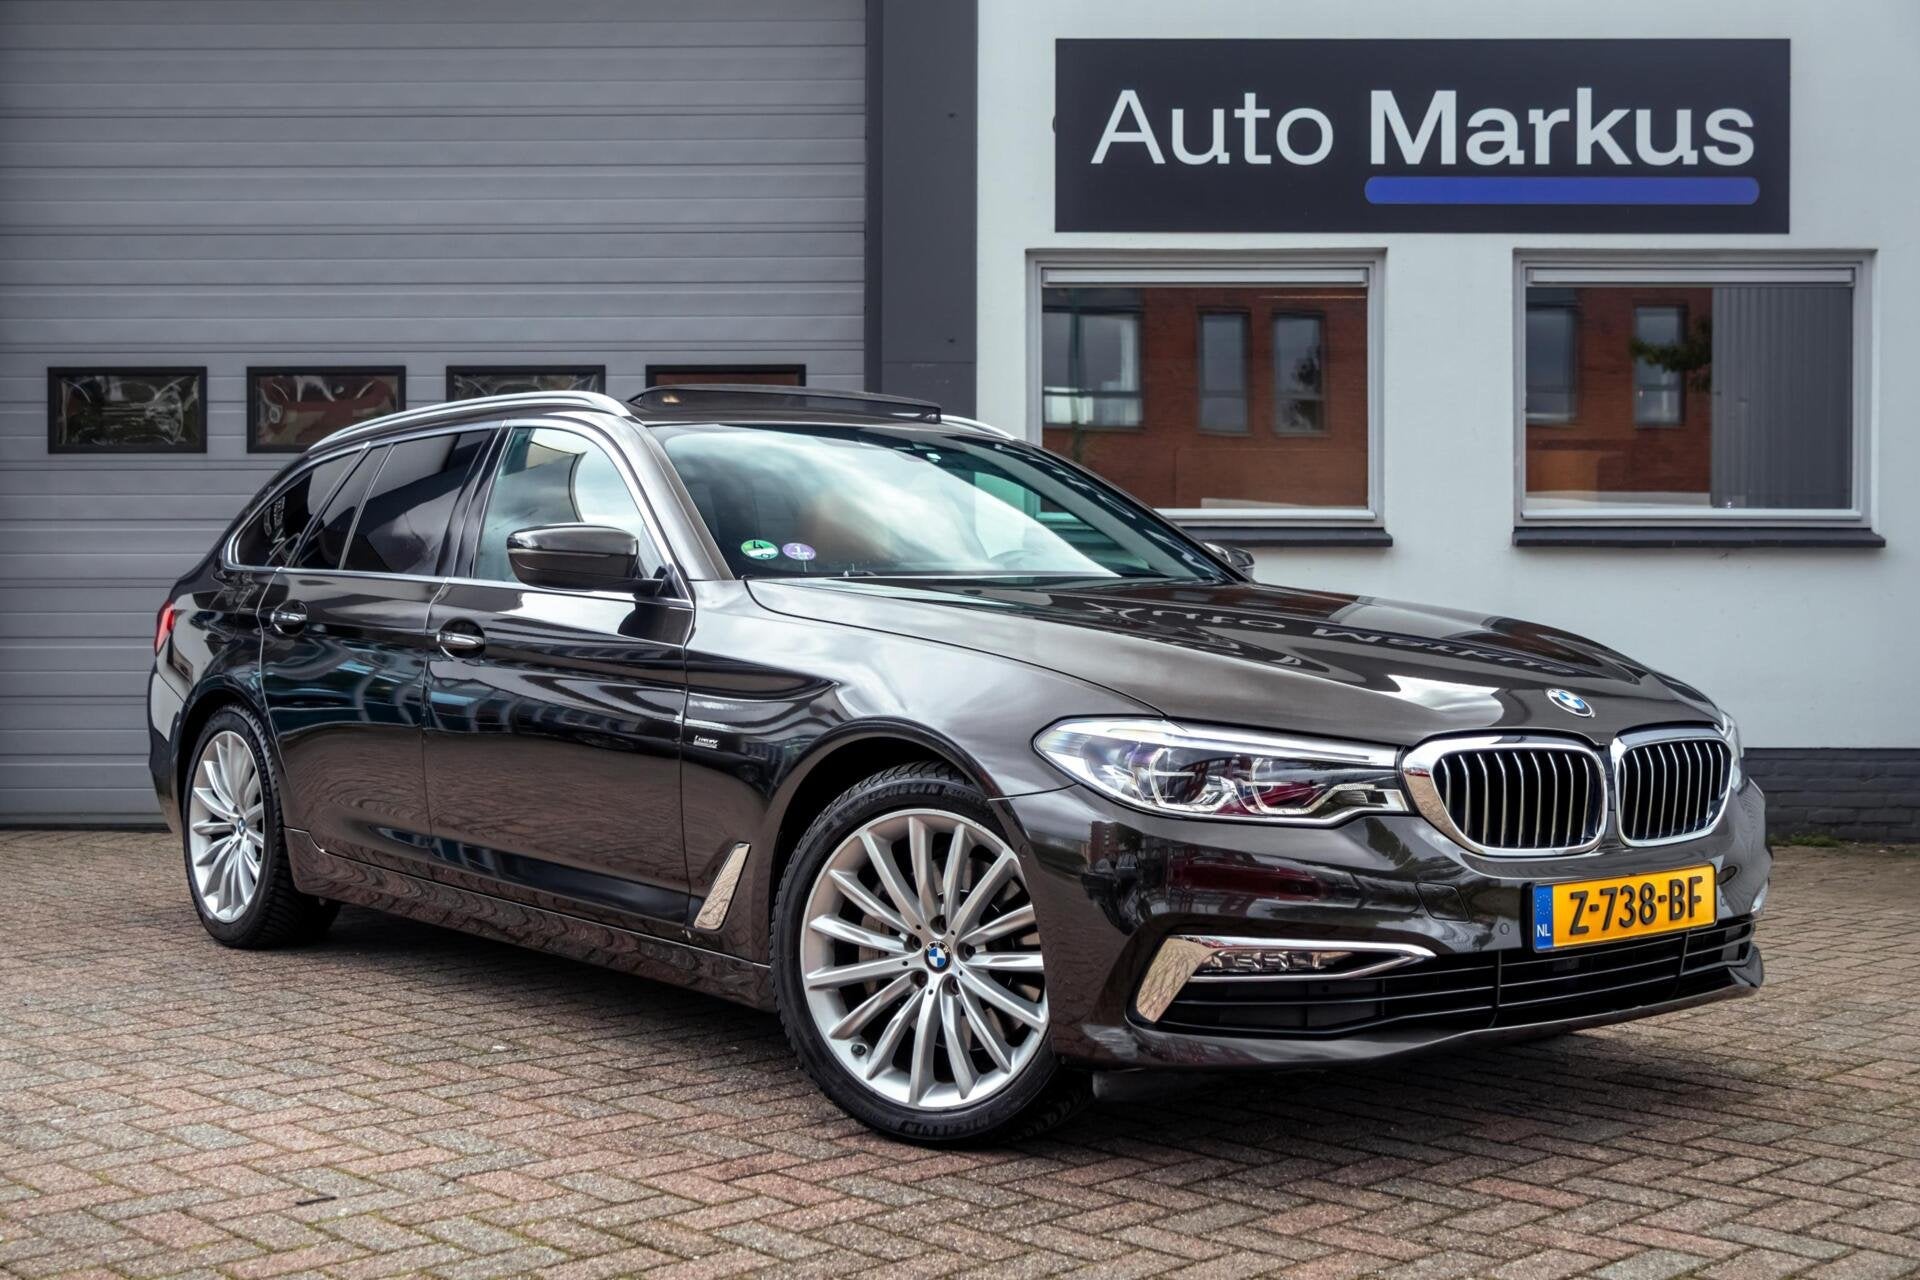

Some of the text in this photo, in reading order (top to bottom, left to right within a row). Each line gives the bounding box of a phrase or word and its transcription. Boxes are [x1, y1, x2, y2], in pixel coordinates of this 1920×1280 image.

[1090, 87, 1755, 167] Auto Markus
[1536, 924, 1551, 937] NL
[1568, 875, 1703, 936] Z-738-BF
